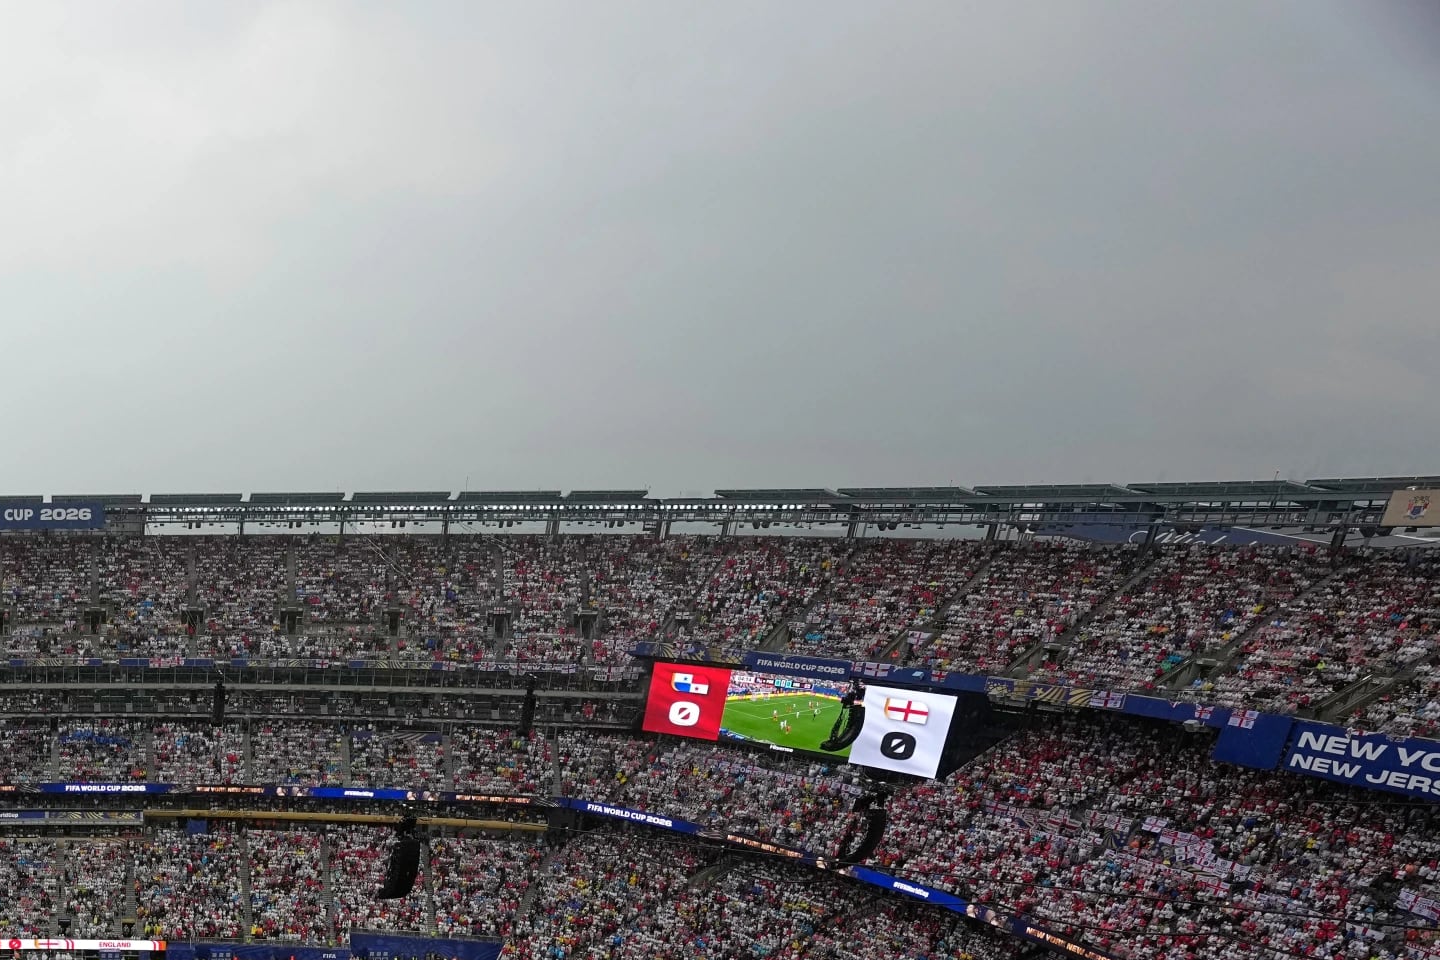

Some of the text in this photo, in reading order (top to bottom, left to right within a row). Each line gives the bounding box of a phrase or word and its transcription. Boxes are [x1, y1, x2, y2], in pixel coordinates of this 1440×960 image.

[4, 508, 34, 521] CUP
[40, 508, 92, 521] 2026
[756, 659, 845, 675] FIFA WORLD CUP 2026
[1297, 731, 1388, 761] NEW
[1289, 753, 1362, 779] NEW
[587, 803, 673, 828] FIFA WORLD CUP 2026
[98, 941, 132, 949] ENGLAND
[1026, 926, 1046, 939] NEW
[1045, 934, 1067, 950] YORK
[1066, 942, 1086, 957] NEW
